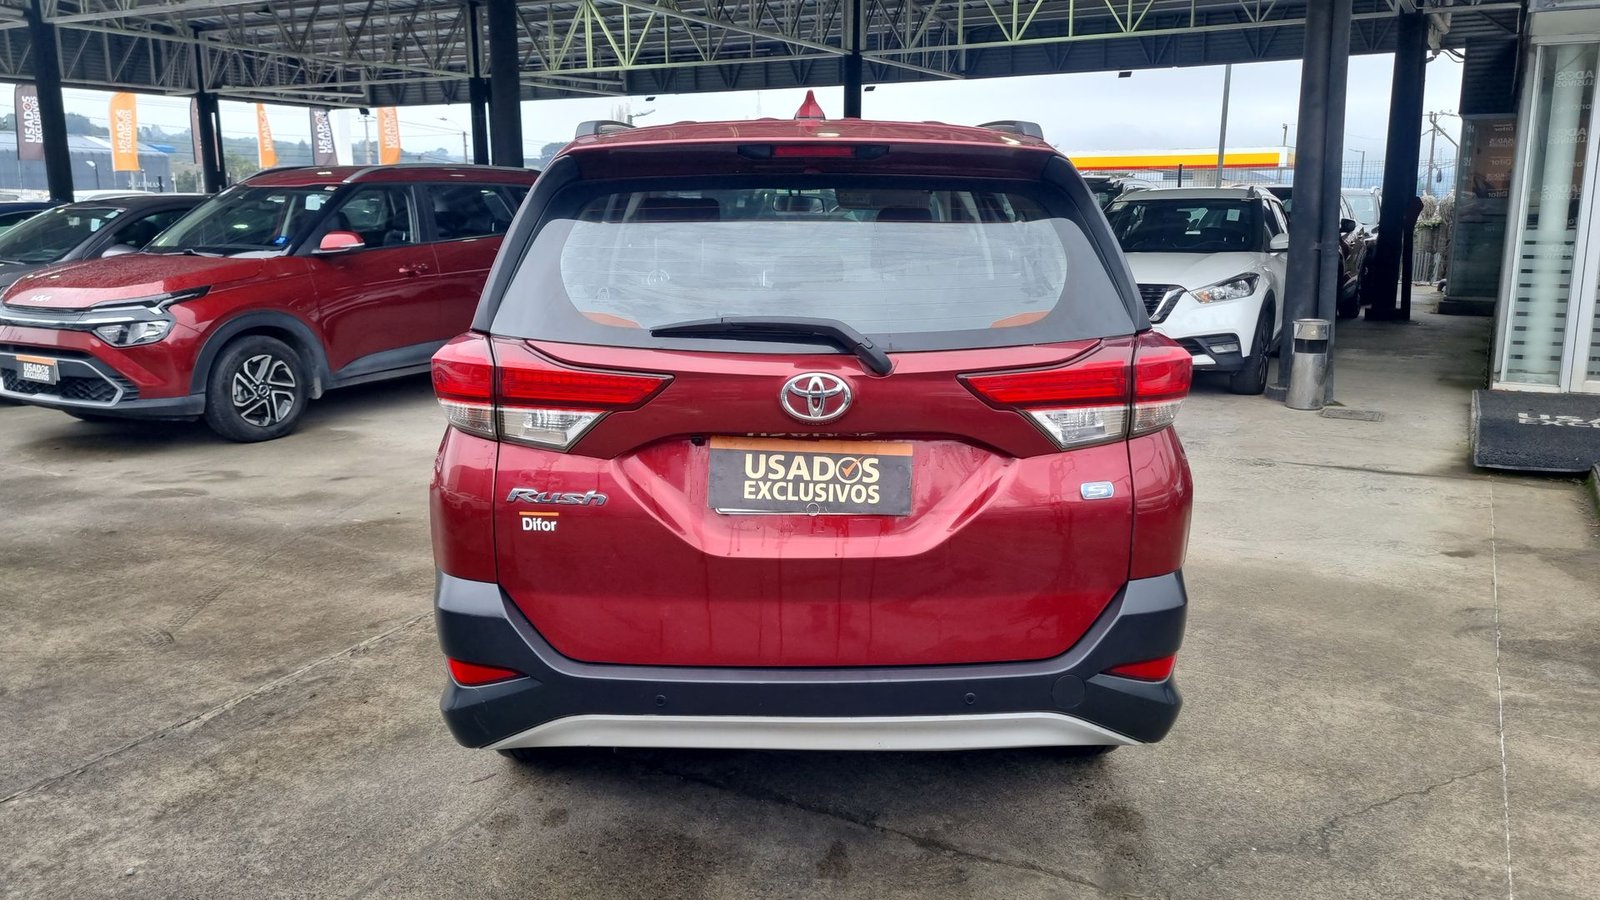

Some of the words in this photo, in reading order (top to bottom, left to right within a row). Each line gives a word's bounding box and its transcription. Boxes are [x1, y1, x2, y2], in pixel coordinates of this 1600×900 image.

[22, 95, 36, 143] USADOS
[31, 95, 44, 143] EXCLUSIVOS
[316, 108, 328, 154] USADOS
[23, 362, 49, 373] USADOS
[744, 453, 880, 484] USADOS
[506, 487, 608, 505] Rush
[743, 480, 880, 504] EXCLUSIVOS
[521, 517, 557, 532] Difor
